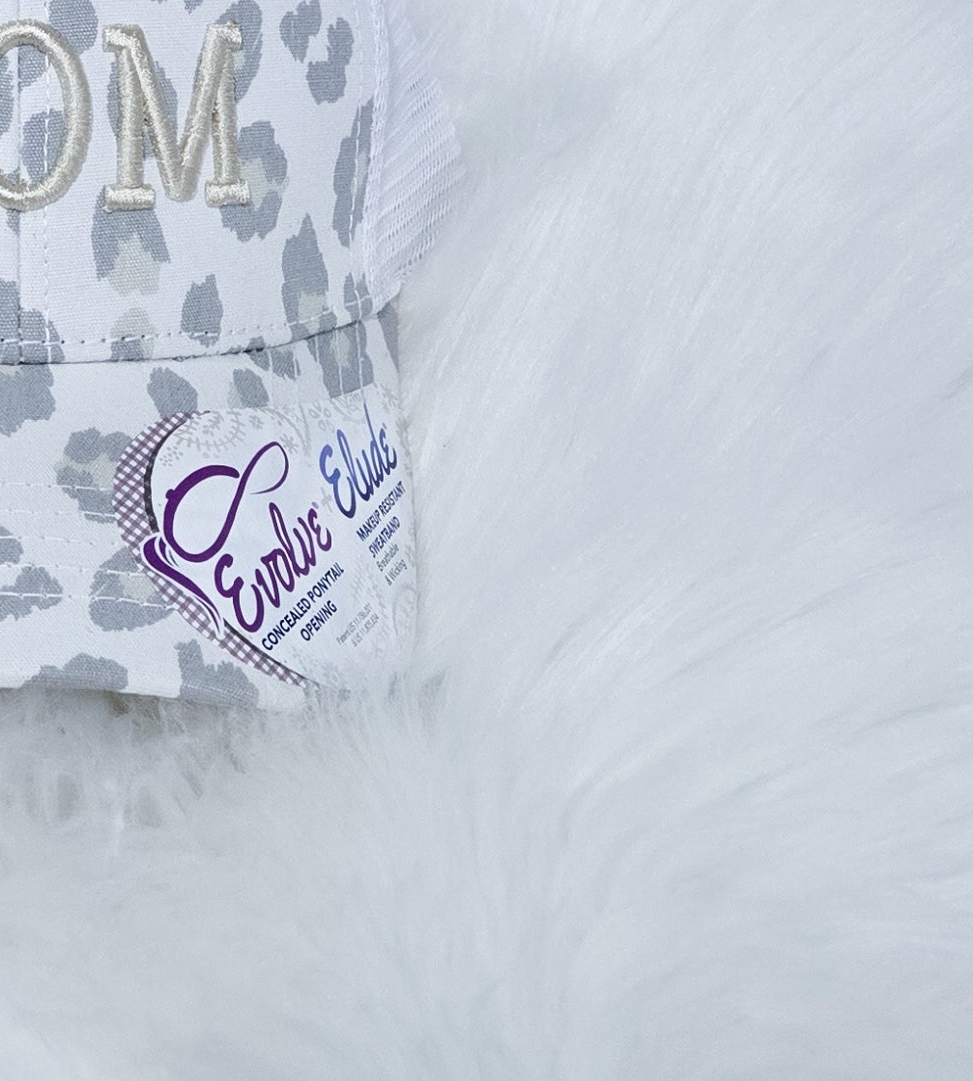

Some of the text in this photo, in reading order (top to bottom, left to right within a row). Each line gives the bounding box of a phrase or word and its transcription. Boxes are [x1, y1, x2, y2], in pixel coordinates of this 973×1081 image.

[320, 401, 397, 518] Elude
[356, 481, 406, 542] MAKEUP RESISTANT
[368, 516, 401, 558] SWEATBAND
[214, 502, 332, 633] Evolve
[262, 562, 344, 651] CONCEALED PONYTAIL
[300, 600, 337, 641] OPENING
